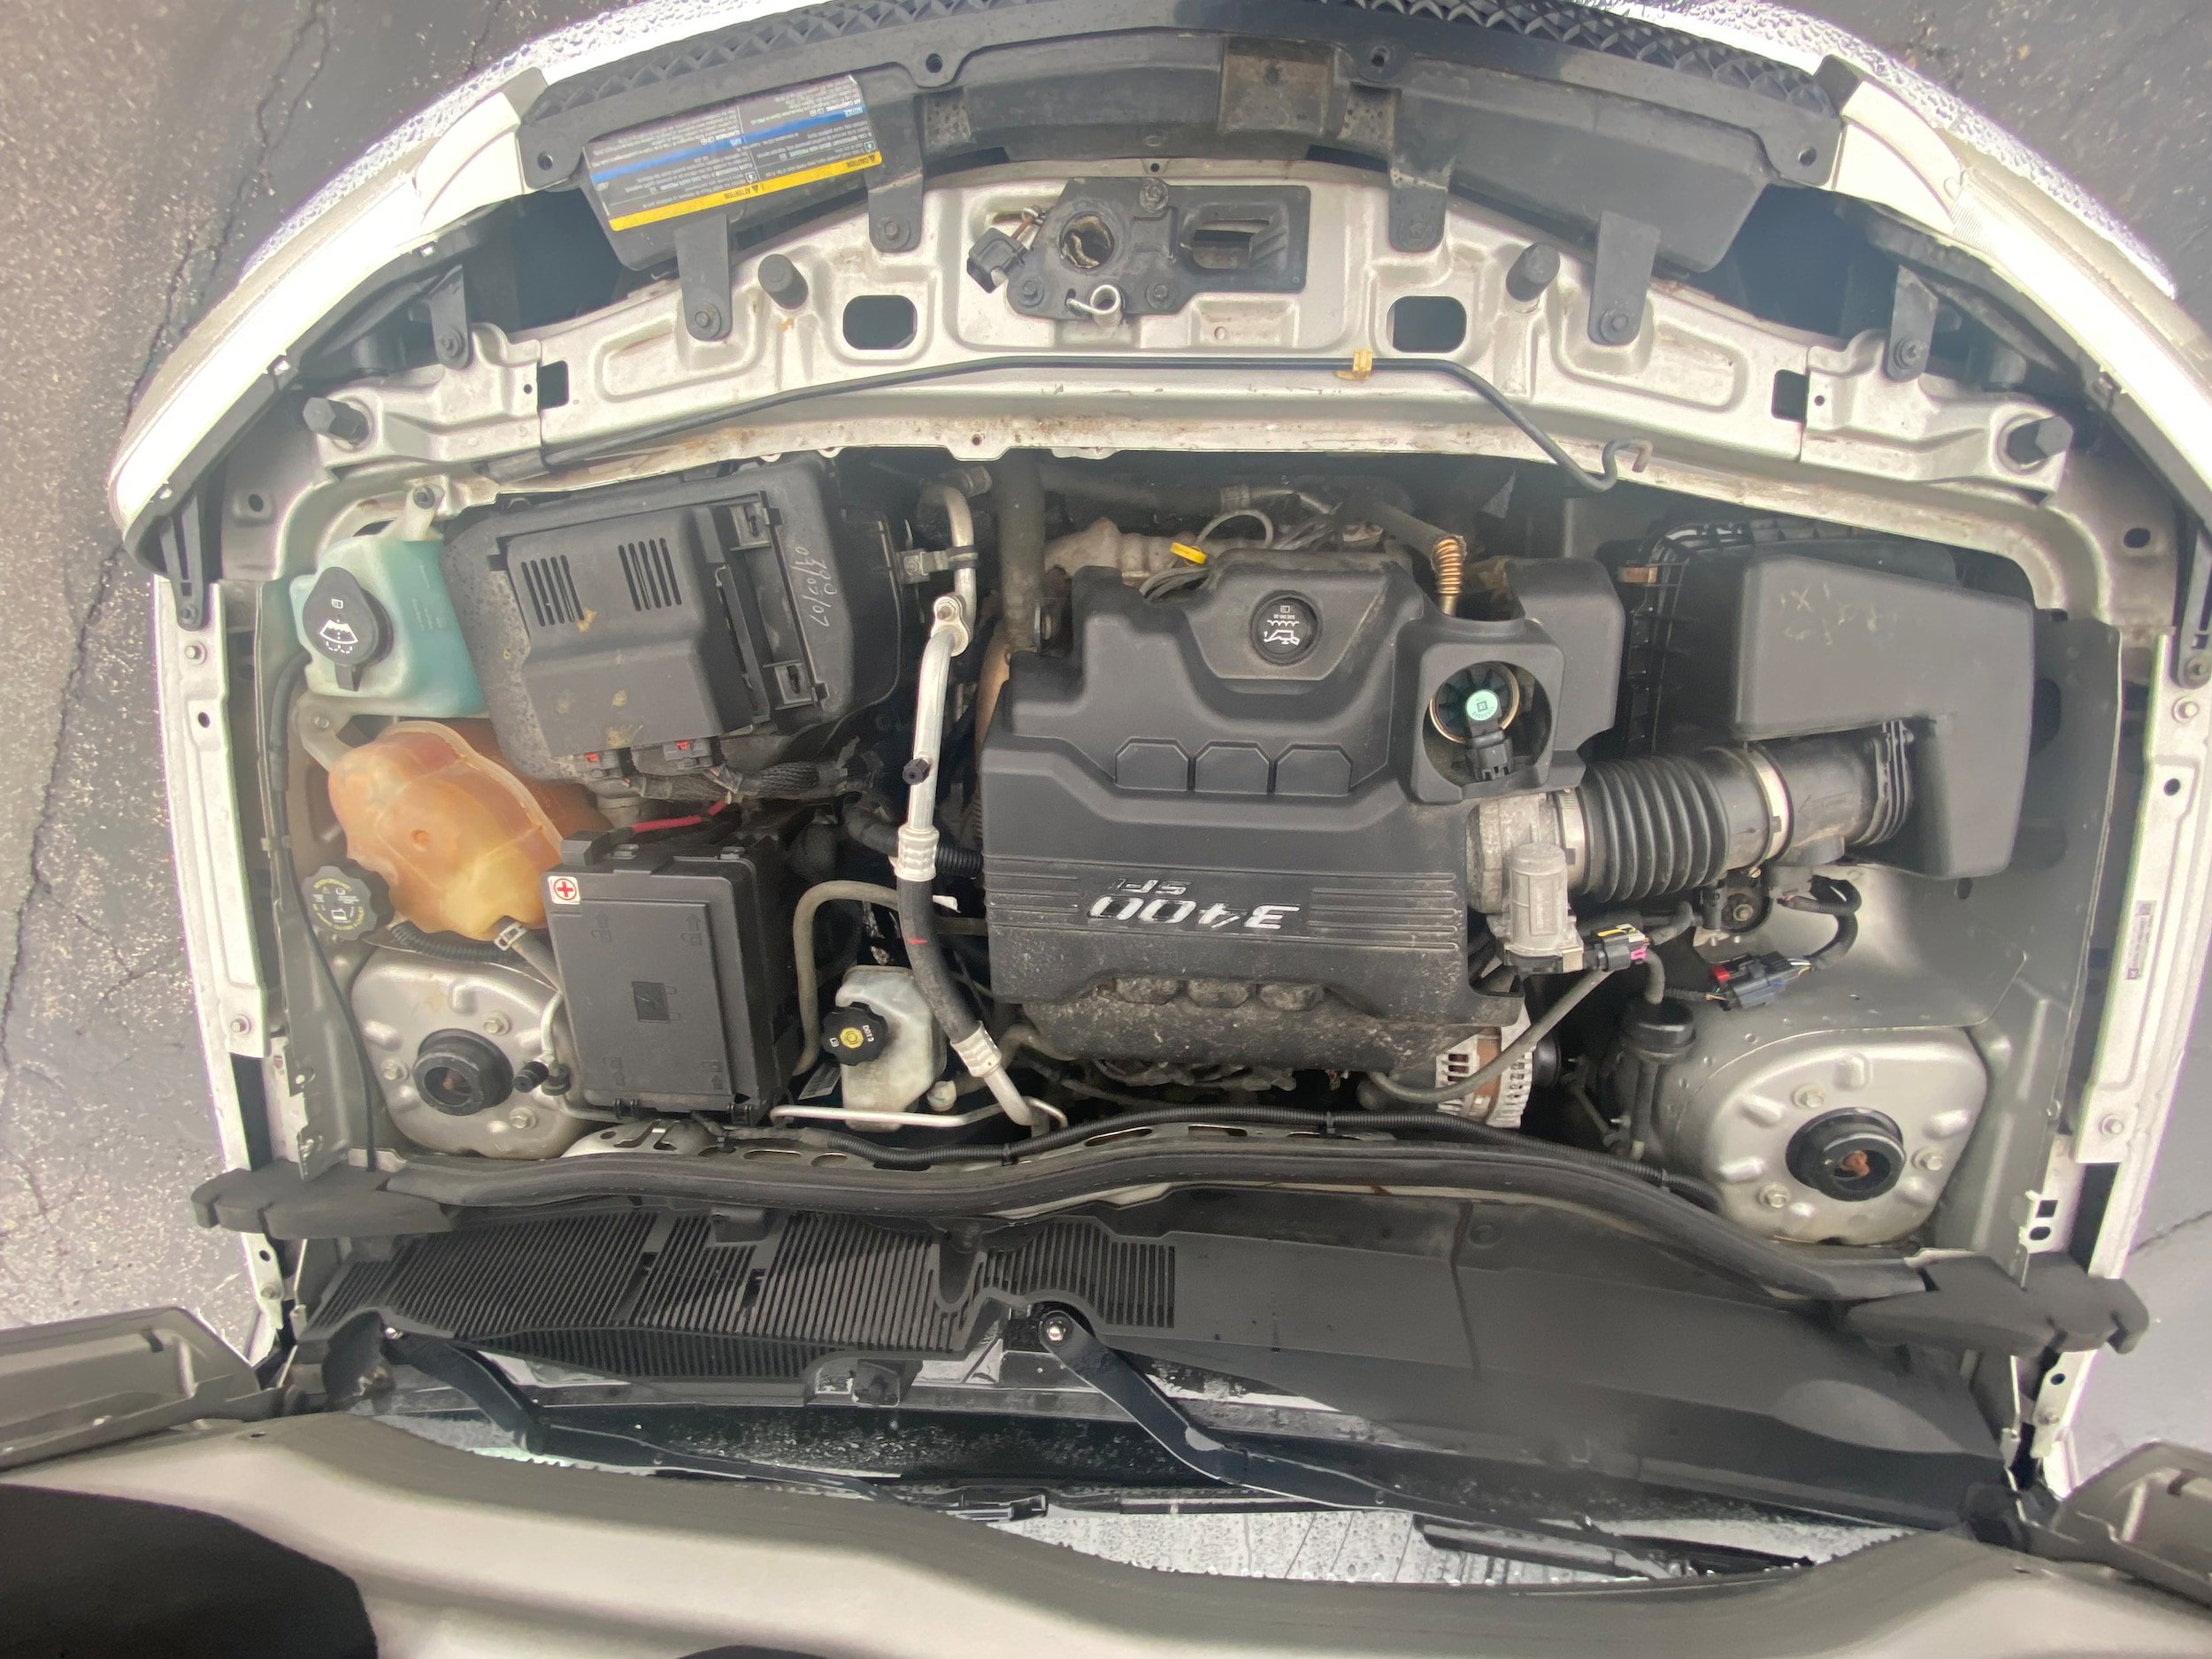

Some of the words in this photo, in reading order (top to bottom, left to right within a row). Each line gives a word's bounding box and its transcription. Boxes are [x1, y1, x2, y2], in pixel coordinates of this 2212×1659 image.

[843, 106, 864, 117] NOTICE
[1087, 895, 1302, 930] 3400
[863, 1025, 872, 1038] DOT
